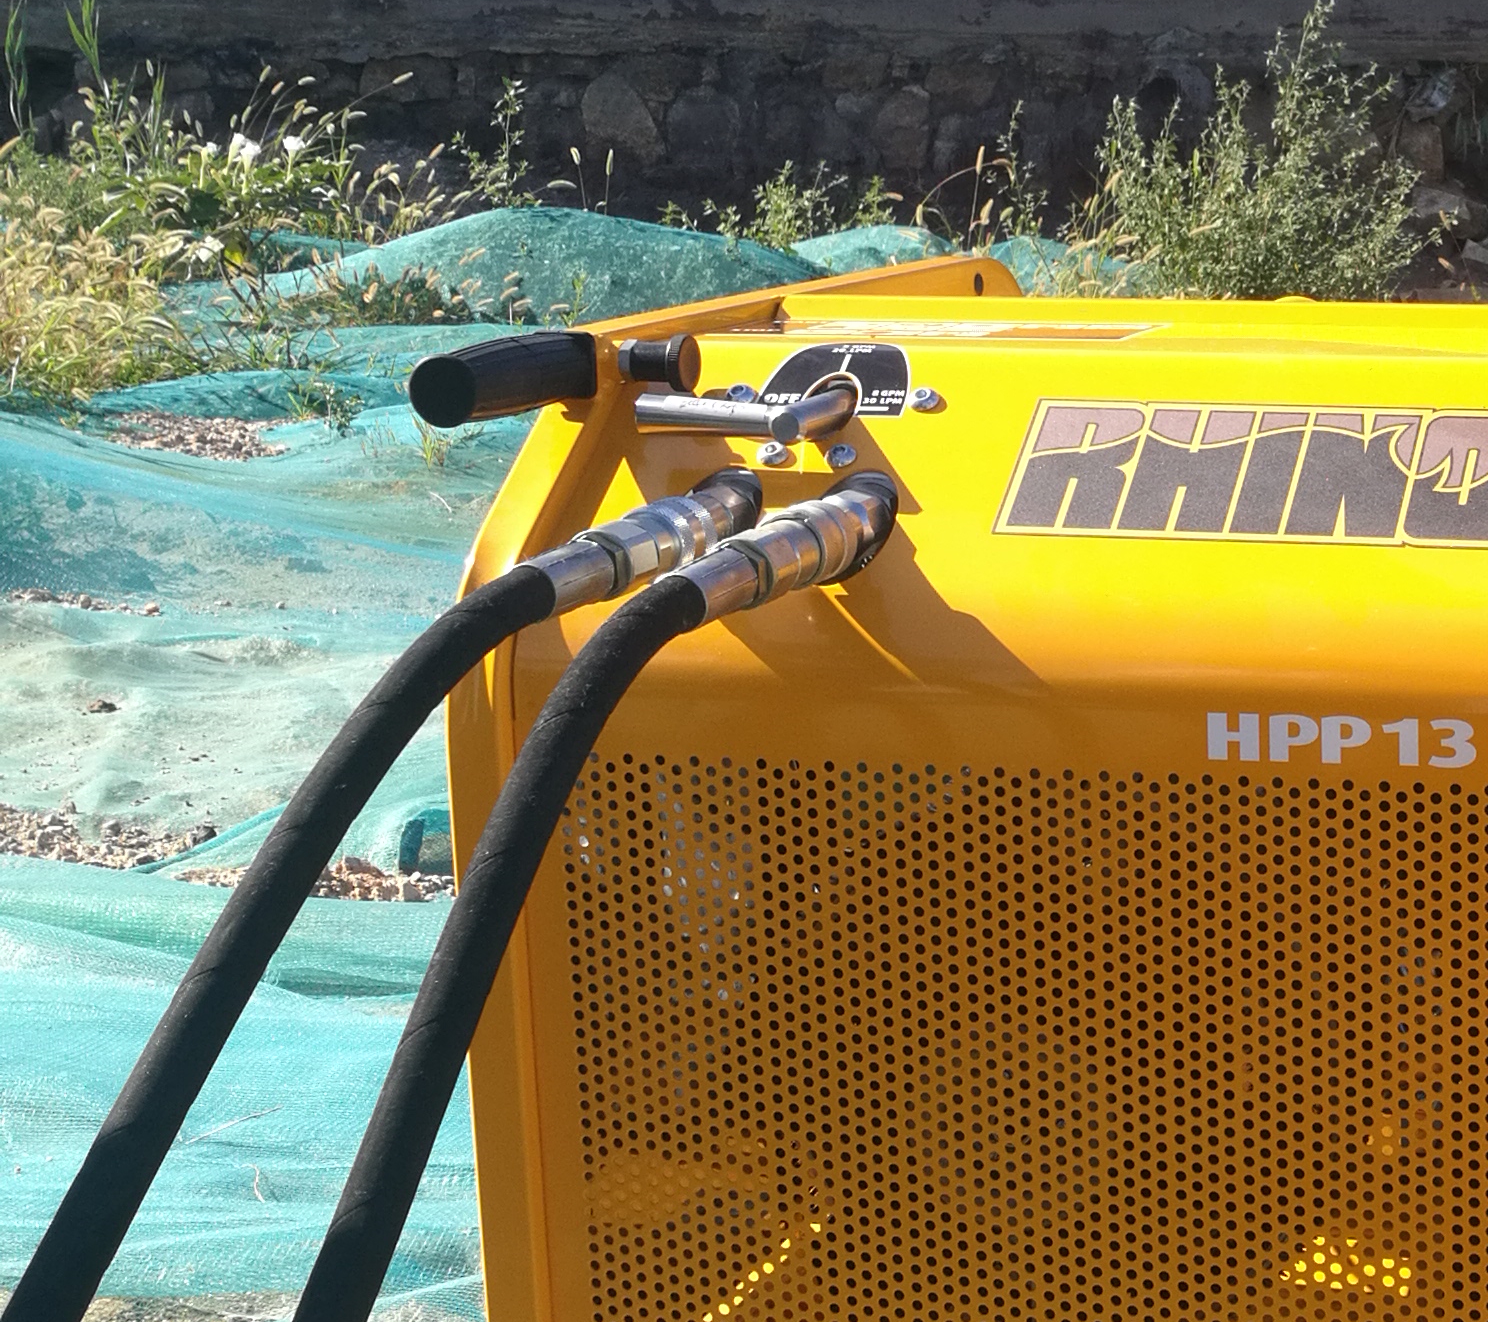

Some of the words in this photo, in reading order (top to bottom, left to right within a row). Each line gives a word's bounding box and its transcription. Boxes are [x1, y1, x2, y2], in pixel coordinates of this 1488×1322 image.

[881, 389, 906, 397] GPM
[764, 393, 801, 404] OFF
[862, 397, 878, 405] 30
[879, 397, 903, 405] LPM
[1206, 712, 1372, 765] HPP
[1382, 717, 1477, 769] 13
